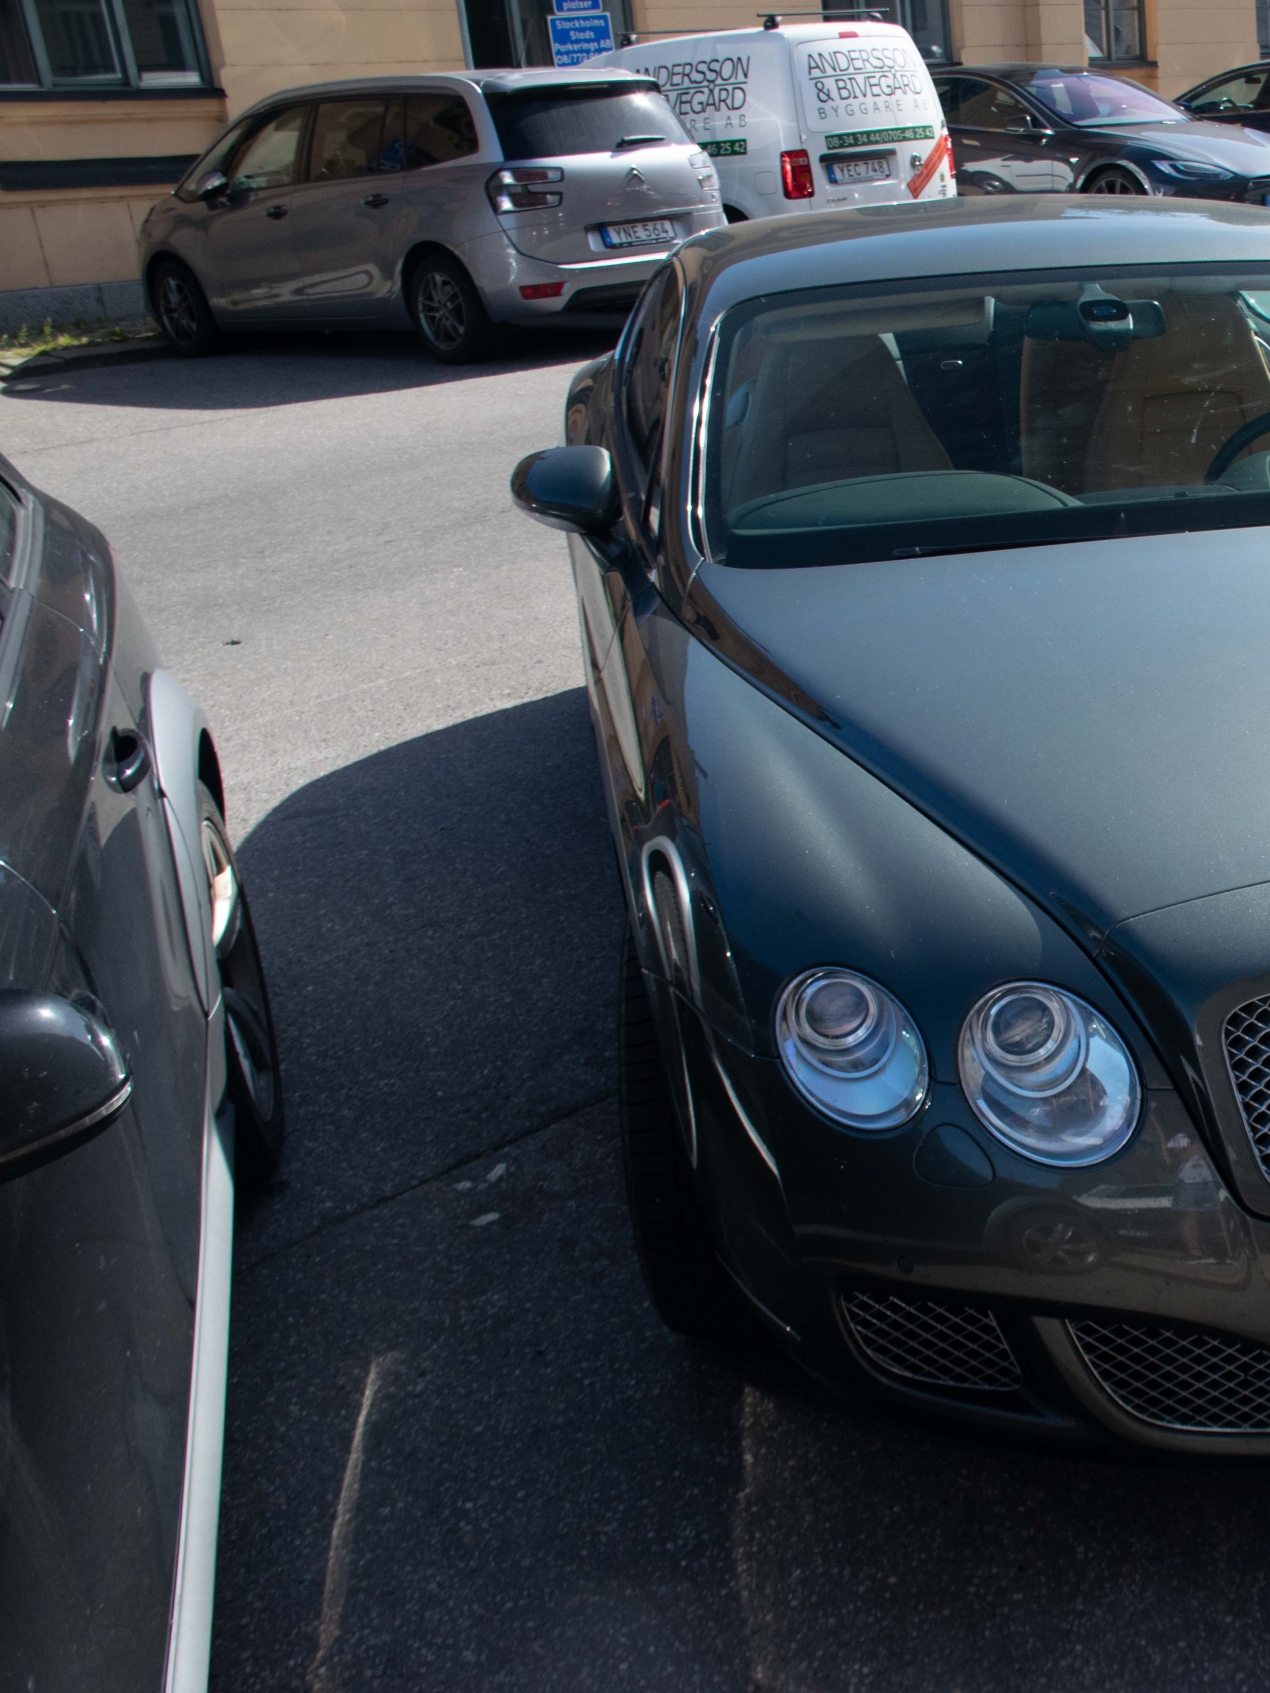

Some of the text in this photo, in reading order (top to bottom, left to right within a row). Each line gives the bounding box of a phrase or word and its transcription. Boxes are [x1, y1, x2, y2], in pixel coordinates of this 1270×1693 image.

[555, 18, 605, 29] Stockholms
[569, 30, 595, 40] Stads
[555, 39, 612, 52] Parkerings AB
[807, 48, 918, 76] ANDERSSON
[814, 80, 836, 103] &
[817, 99, 903, 120] BYGGARE
[725, 114, 747, 129] AB
[720, 142, 732, 154] 25
[733, 141, 746, 153] 42
[827, 134, 854, 147] 08-34
[856, 133, 867, 145] 34
[838, 160, 885, 178] YEC 748
[613, 222, 669, 241] YNE 564
